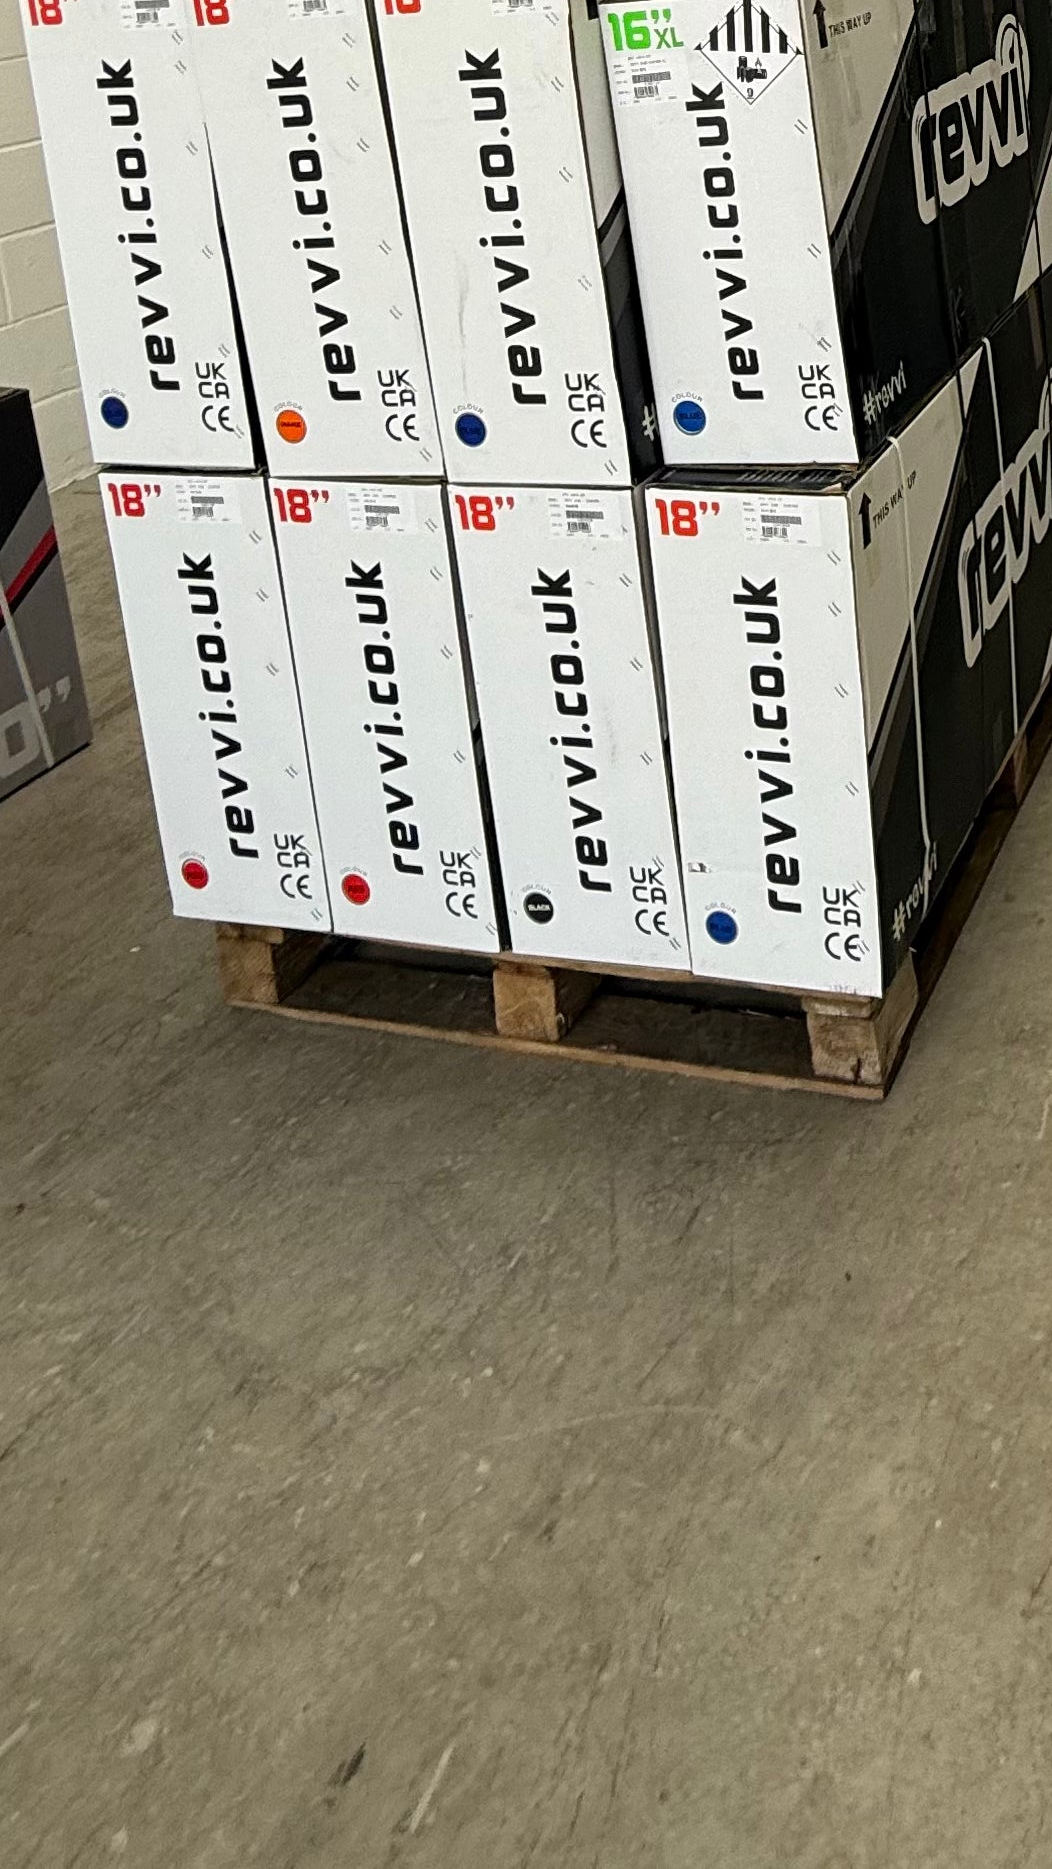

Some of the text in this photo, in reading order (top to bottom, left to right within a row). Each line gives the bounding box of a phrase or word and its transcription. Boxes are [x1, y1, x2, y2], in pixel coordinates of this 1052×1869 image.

[654, 27, 684, 49] XL
[912, 13, 1030, 224] revvi
[97, 60, 180, 390] revvi.co.uk
[267, 58, 361, 400] revvi.co.uk
[459, 49, 546, 404] revvi.co.uk
[686, 82, 763, 399] revvi.co.uk
[196, 363, 225, 379] UK
[377, 369, 409, 387] UK
[799, 365, 830, 380] UK
[199, 382, 229, 398] CA
[564, 373, 600, 391] UK
[802, 383, 835, 398] CA
[381, 390, 416, 407] CA
[568, 394, 604, 412] CA
[872, 501, 889, 529] THIS
[907, 470, 916, 490] UP
[178, 553, 258, 858] revvi.co.uk
[346, 561, 423, 875] revvi.co.uk
[532, 569, 611, 892] revvi.co.uk
[734, 577, 801, 912] revvi.co.uk
[274, 834, 306, 850] UK
[277, 852, 310, 868] CA
[439, 850, 472, 869] UK
[443, 870, 475, 887] CA
[629, 866, 662, 886] UK
[633, 886, 667, 904] CA
[823, 886, 859, 908] UK
[825, 908, 860, 927] CA
